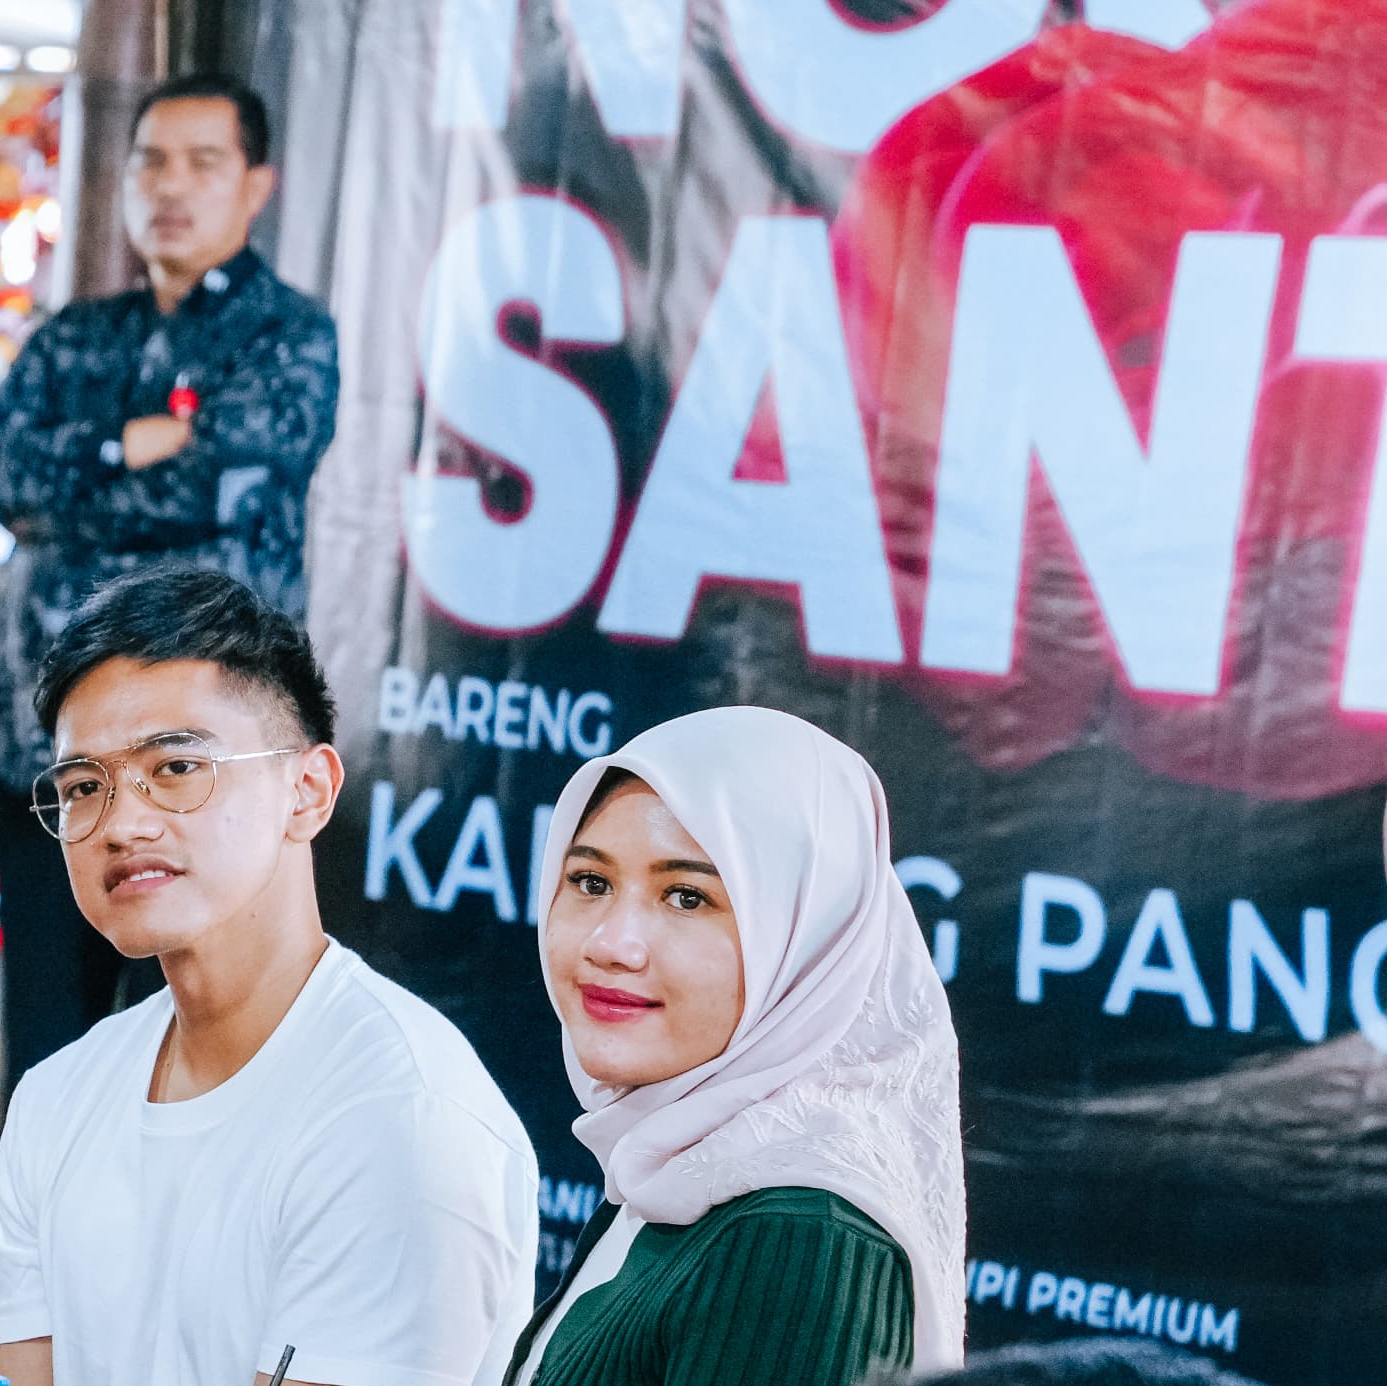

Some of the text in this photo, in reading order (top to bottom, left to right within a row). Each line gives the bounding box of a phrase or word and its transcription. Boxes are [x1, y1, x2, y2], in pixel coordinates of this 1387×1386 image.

[379, 665, 613, 760] BARENG
[967, 1258, 1240, 1354] PI PREMIUM
